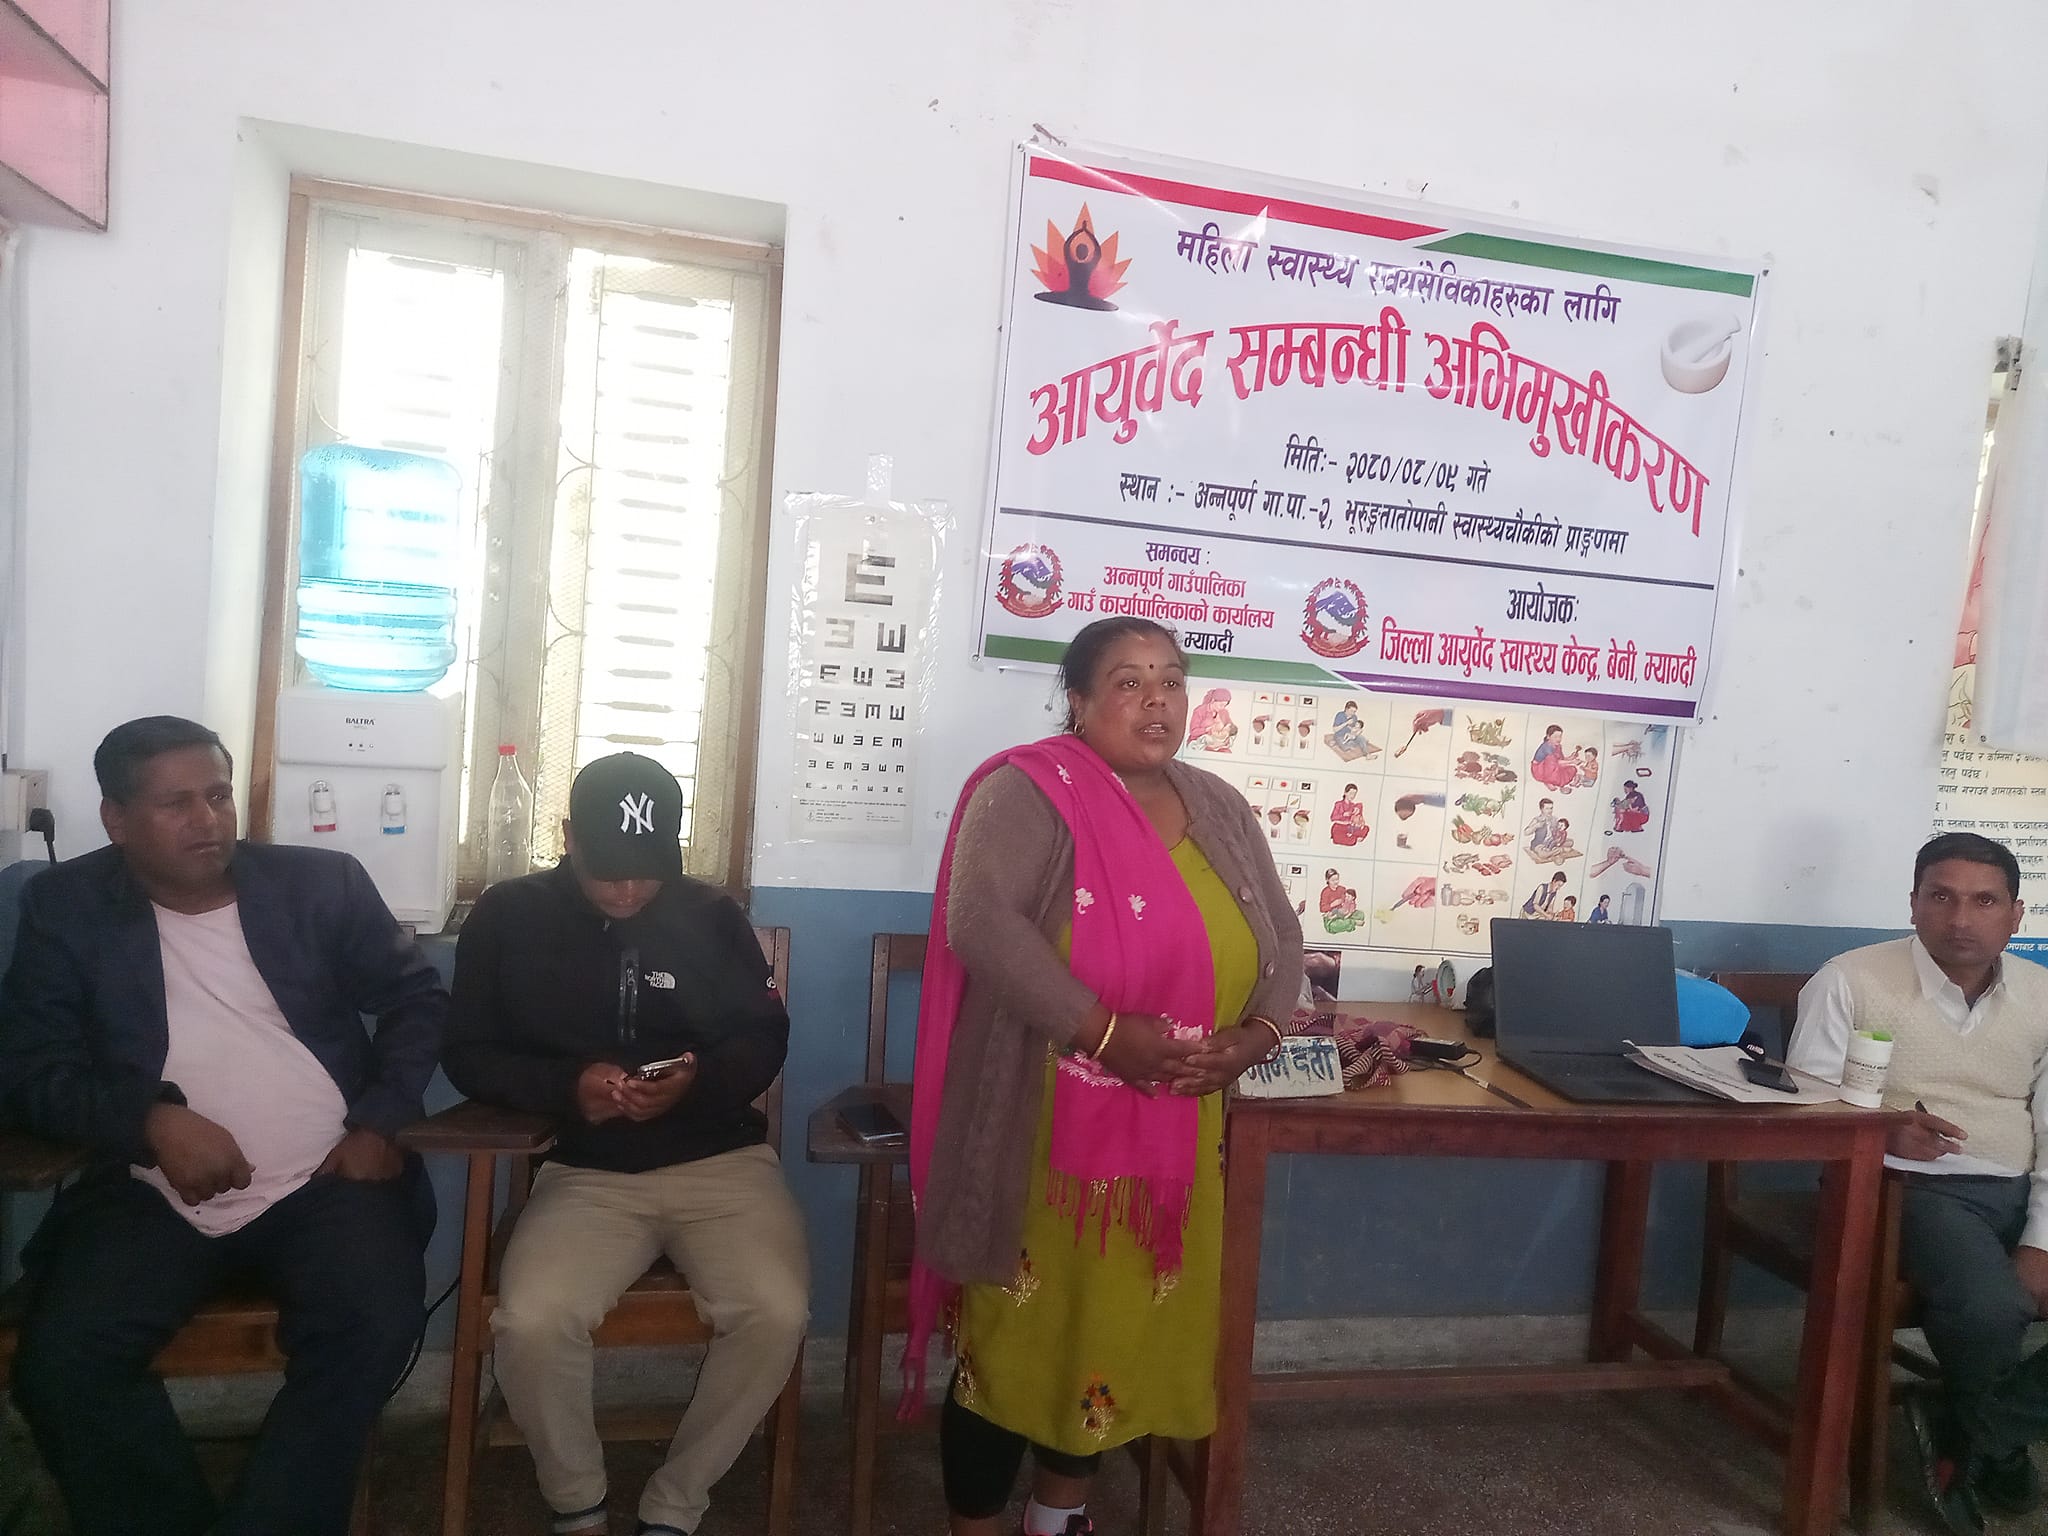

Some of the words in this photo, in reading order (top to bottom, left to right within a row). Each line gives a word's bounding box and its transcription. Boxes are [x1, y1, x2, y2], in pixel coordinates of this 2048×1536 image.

[1176, 222, 1258, 274] महिला
[1267, 244, 1360, 289] स्वास्थ्य
[1563, 283, 1622, 324] लागि
[1026, 319, 1215, 455] आयुर्वेद
[1225, 305, 1411, 401] सम्बन्धी
[1424, 321, 1710, 538] अभिमुखीकरण
[1119, 472, 1161, 503] स्थान
[1194, 479, 1257, 521] अन्नपूर्ण
[1466, 459, 1492, 494] गते
[1145, 542, 1202, 566] समन्वय
[1103, 565, 1164, 594] अन्नपूर्ण
[1168, 569, 1247, 599] गाउँपालिका
[1067, 587, 1097, 613] गाउँ
[1212, 602, 1275, 629] कार्यालय
[1184, 629, 1235, 654] म्याग्दी
[1379, 615, 1434, 665] जिल्ला
[1437, 625, 1497, 678] आयुर्वेद
[1499, 636, 1558, 676] स्वास्थ्य
[1643, 645, 1698, 688] म्याग्दी
[345, 717, 376, 726] BALTRA
[618, 792, 655, 835] NY
